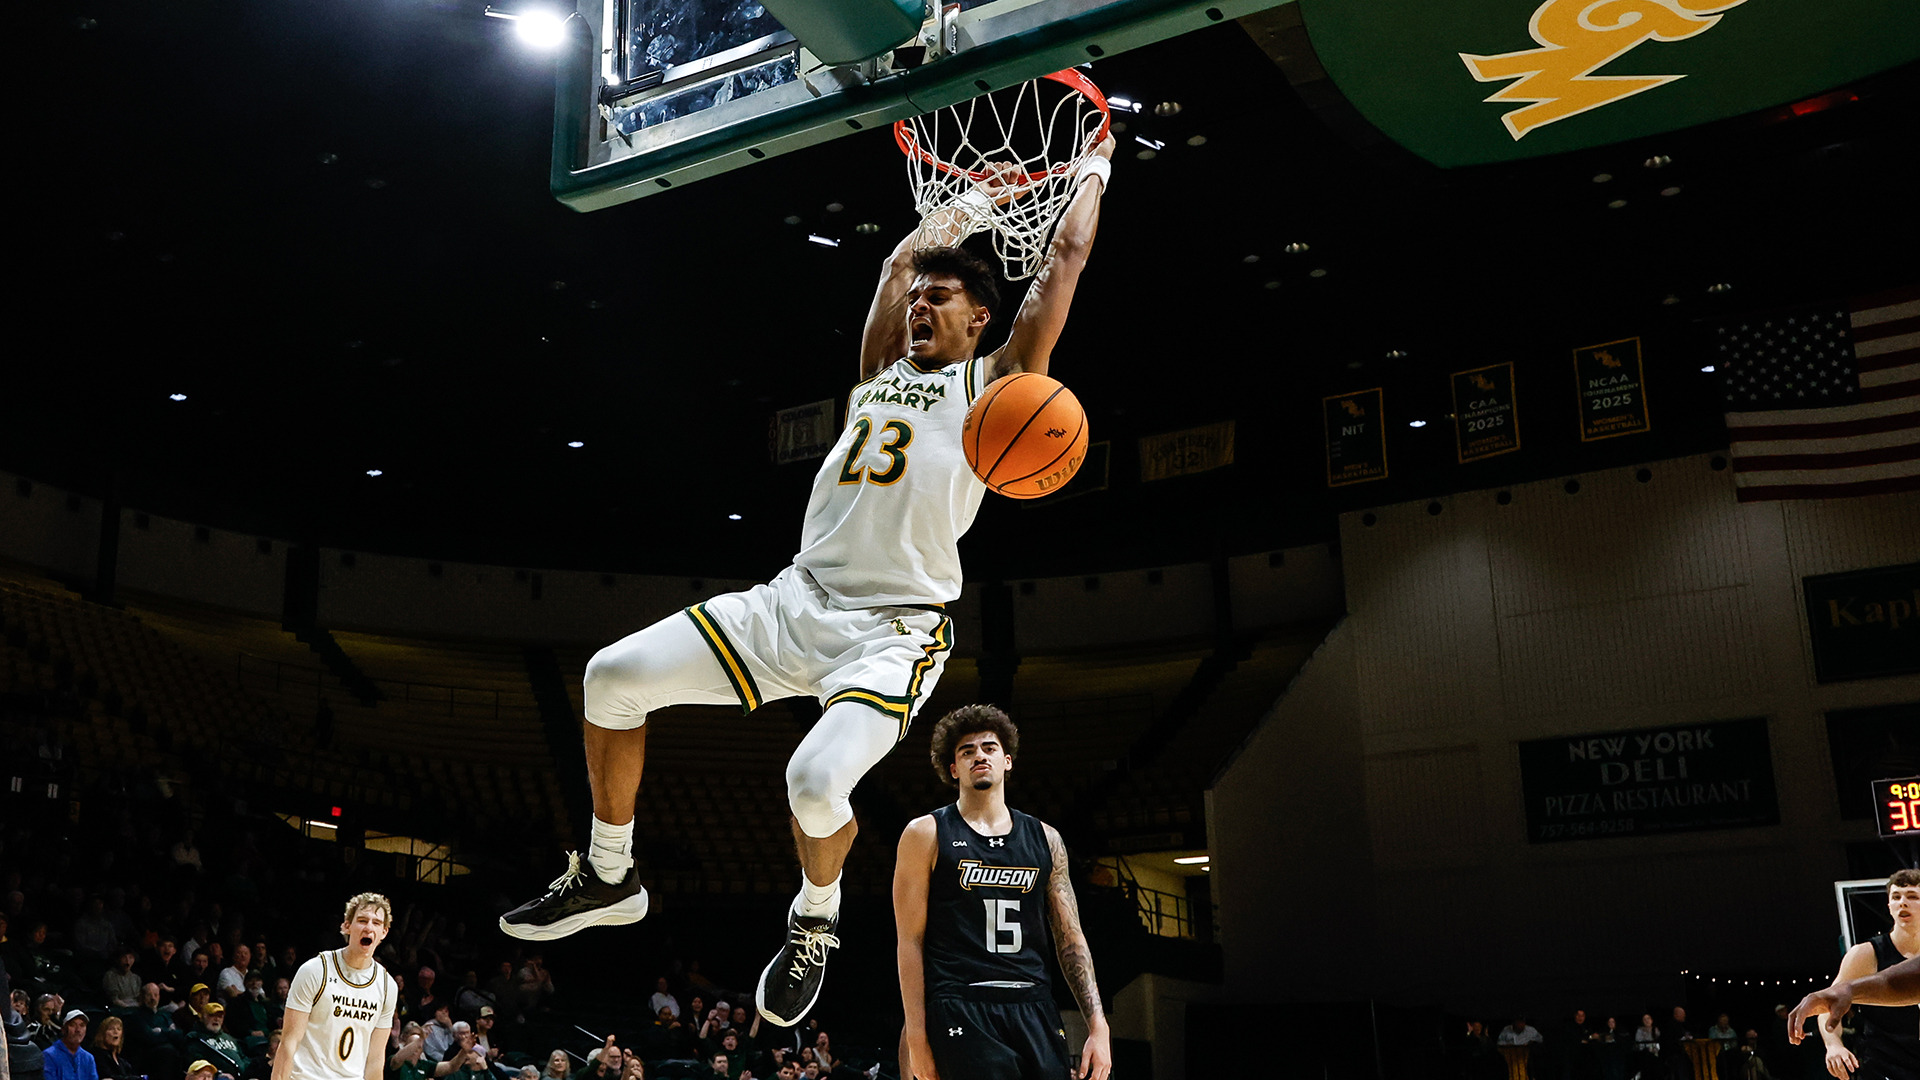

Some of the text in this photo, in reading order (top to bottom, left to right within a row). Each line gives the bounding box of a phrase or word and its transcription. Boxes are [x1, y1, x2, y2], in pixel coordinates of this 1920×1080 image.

[1589, 373, 1629, 388] NCAA
[1469, 397, 1498, 410] CAA
[1592, 393, 1632, 410] 2025
[1342, 423, 1365, 437] NIT
[1467, 414, 1505, 432] 2025
[838, 416, 915, 487] 23
[1568, 728, 1714, 762] NEW YORK
[1600, 755, 1688, 786] DELI
[1544, 779, 1751, 817] PIZZA RESTAURANT
[1889, 782, 1920, 800] 9:0
[983, 899, 1023, 954] 15
[332, 994, 378, 1011] WILLIAM
[339, 1026, 354, 1061] 0
